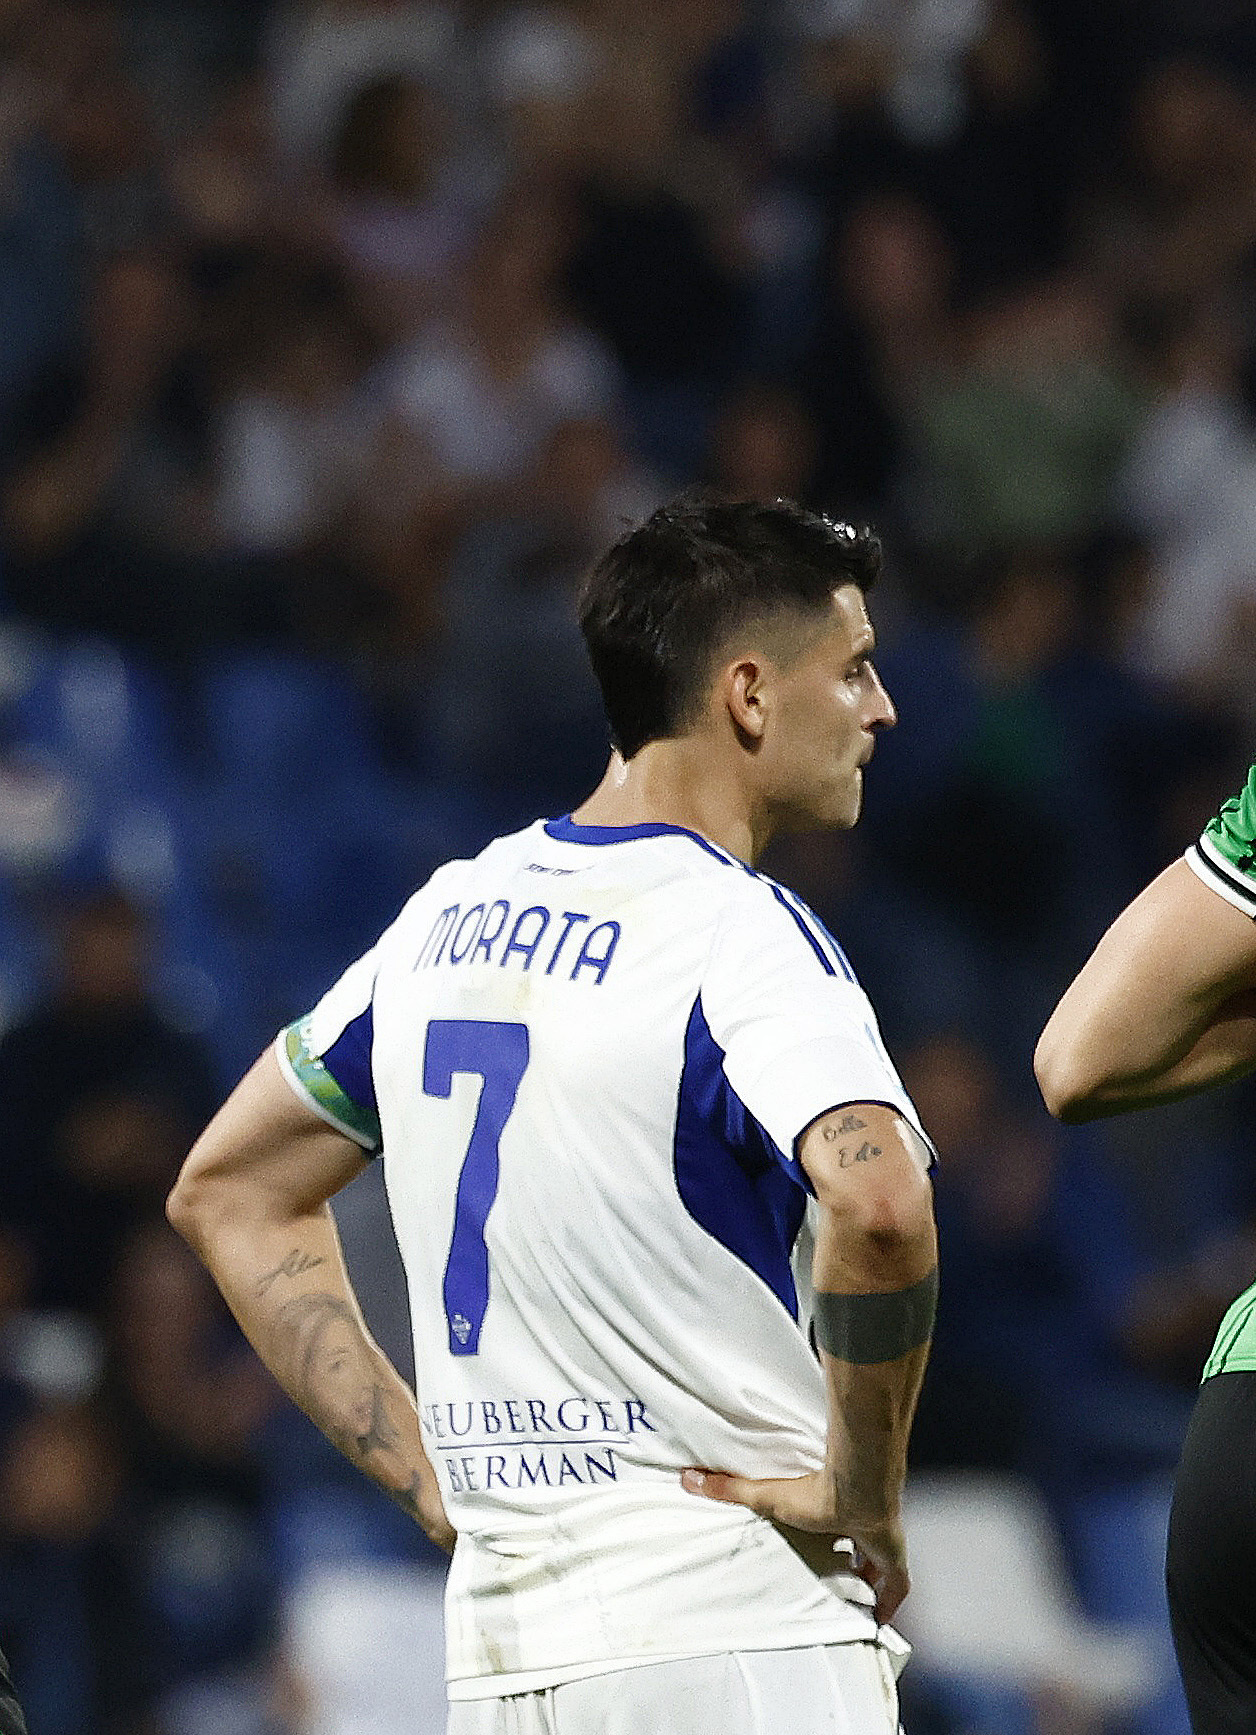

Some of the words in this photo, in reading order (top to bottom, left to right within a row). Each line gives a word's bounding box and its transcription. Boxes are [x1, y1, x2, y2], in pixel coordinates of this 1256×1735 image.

[413, 899, 621, 986] MORATA
[423, 1020, 530, 1356] 7
[446, 1449, 618, 1492] BERMAN
